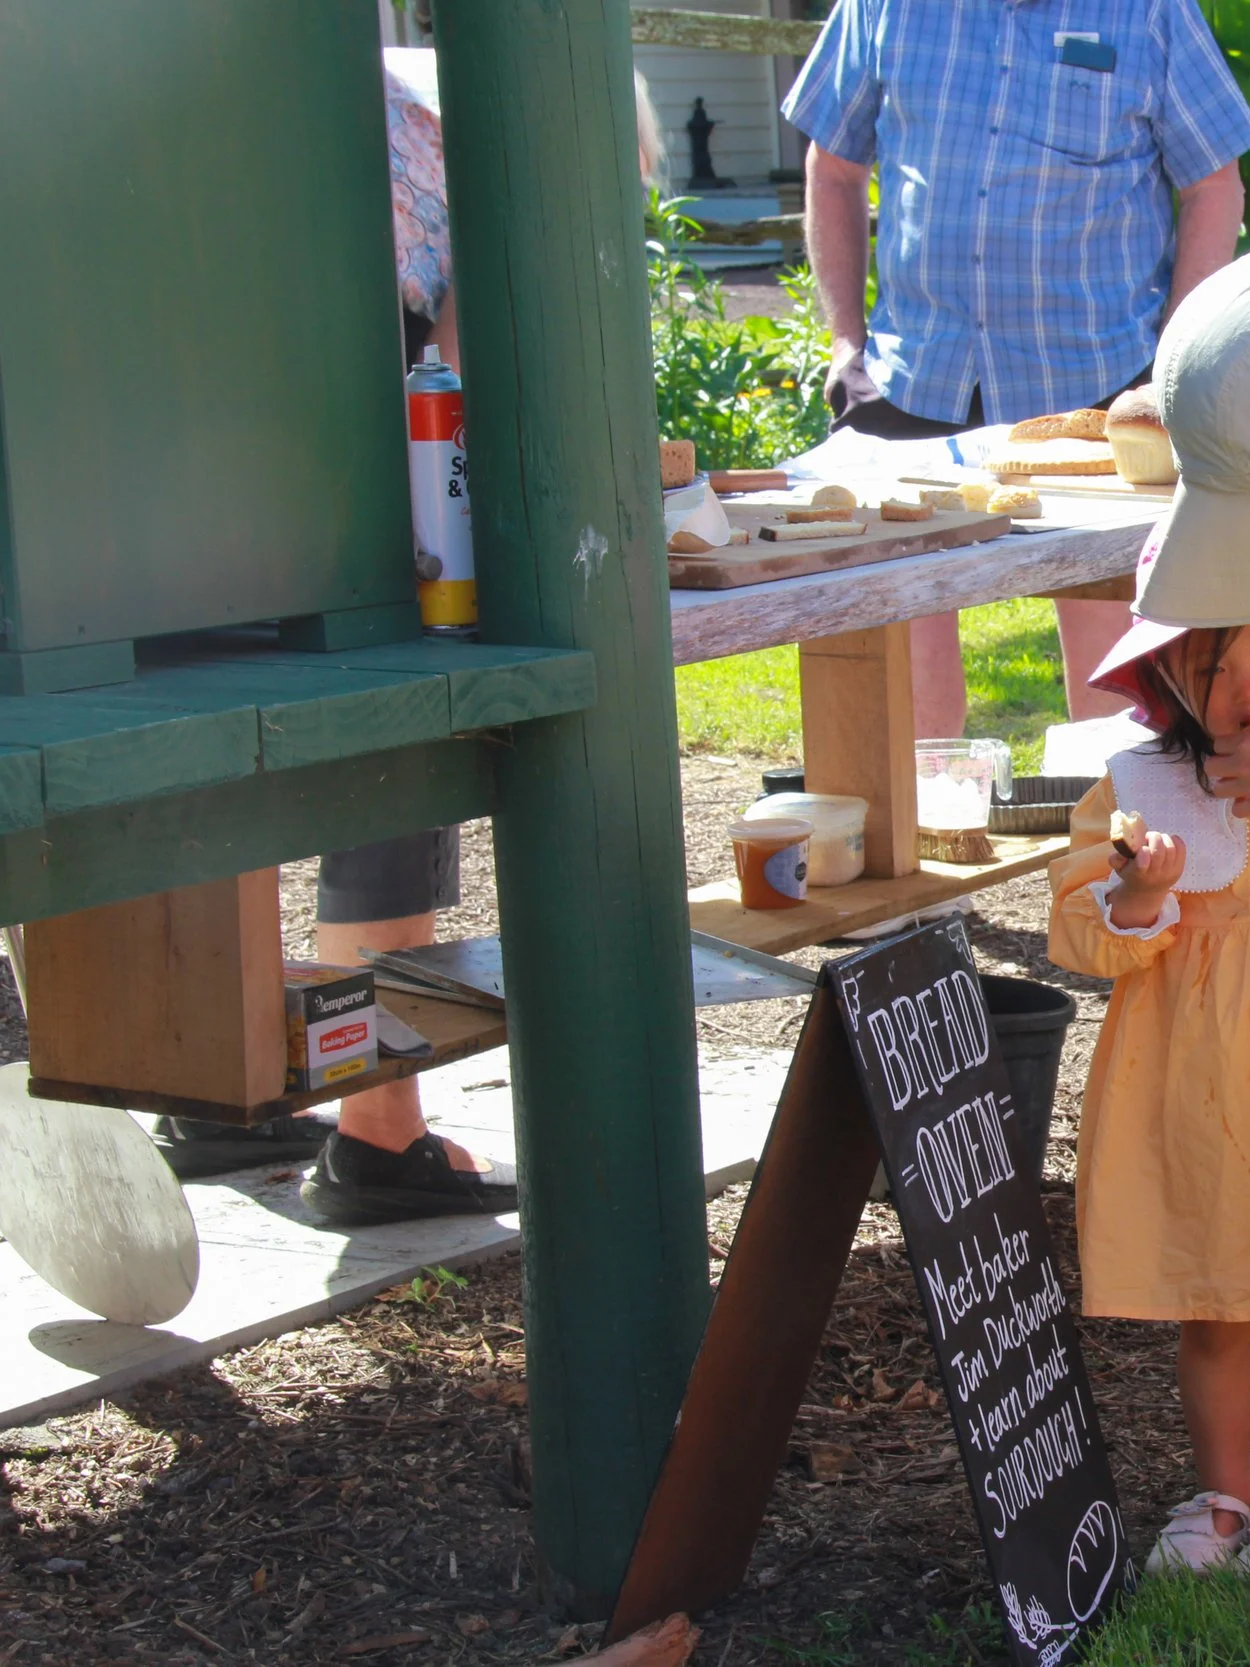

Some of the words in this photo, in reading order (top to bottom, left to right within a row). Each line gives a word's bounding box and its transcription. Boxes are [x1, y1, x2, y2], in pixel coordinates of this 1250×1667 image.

[448, 480, 463, 498] &
[322, 1036, 345, 1049] Baking
[346, 1030, 364, 1041] Paper
[867, 970, 990, 1111] BREAD
[924, 1242, 981, 1340] Meet
[974, 1213, 1030, 1302] baker
[951, 1348, 989, 1402] Jim
[983, 1256, 1066, 1370] Duckworth
[968, 1419, 983, 1451] +
[978, 1387, 1026, 1452] learn
[1026, 1324, 1070, 1409] about
